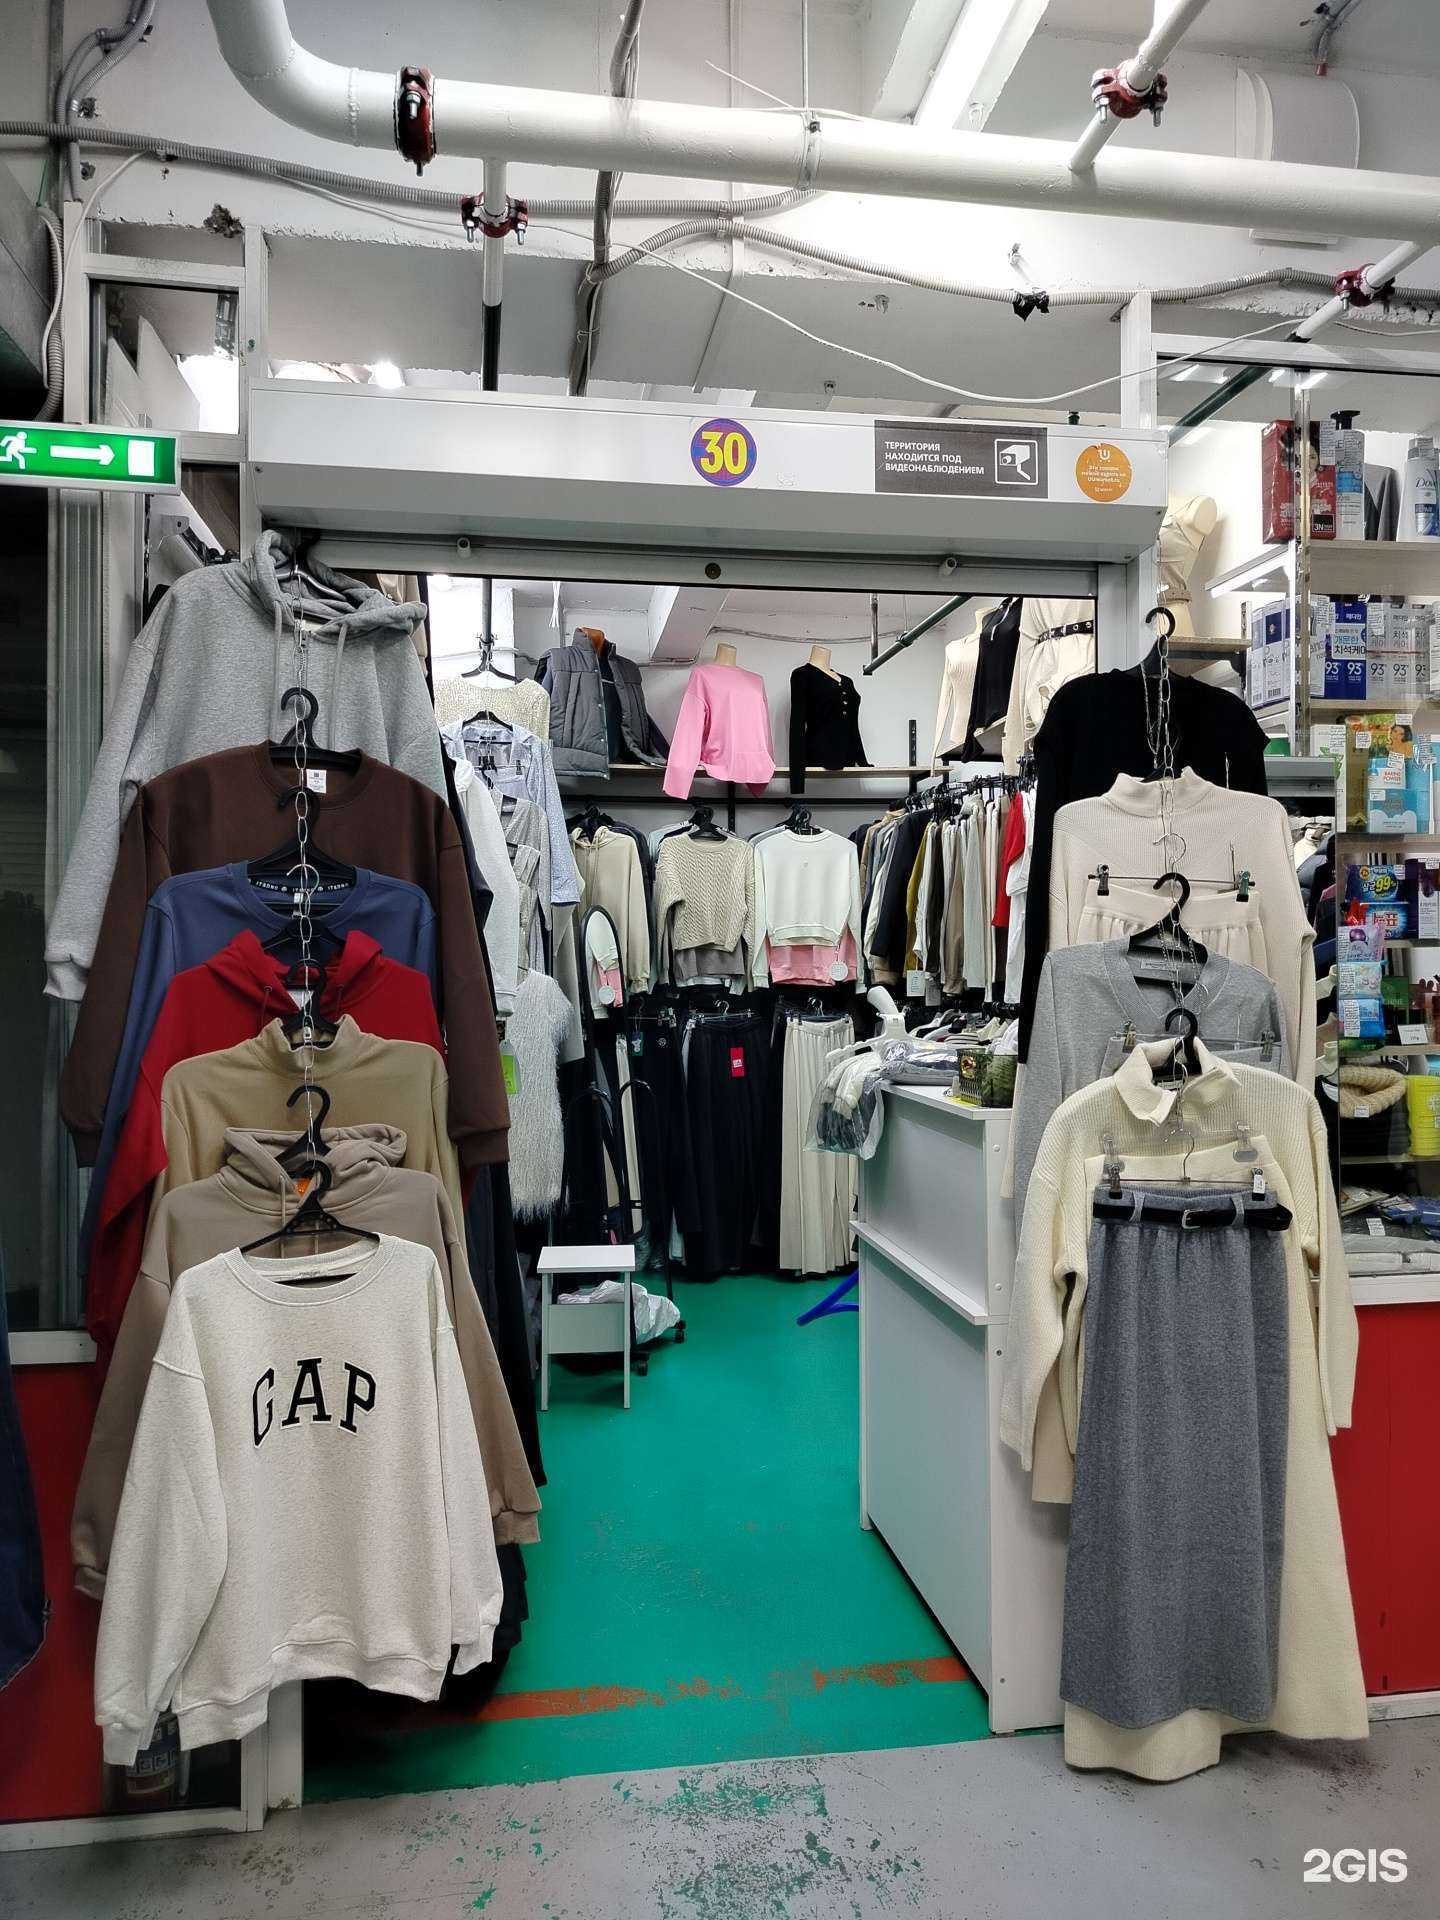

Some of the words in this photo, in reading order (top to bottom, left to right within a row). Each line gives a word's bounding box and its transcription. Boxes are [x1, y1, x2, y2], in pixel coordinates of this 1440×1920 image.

[885, 441, 941, 451] ТЕРРИТОРИЯ
[700, 431, 748, 475] 30
[885, 452, 940, 462] НАХОДИТСЯ
[942, 454, 962, 464] ПОД
[885, 463, 985, 475] ВИДЕОНАБЛЮДЕНИЕМ
[252, 1357, 377, 1447] GAP
